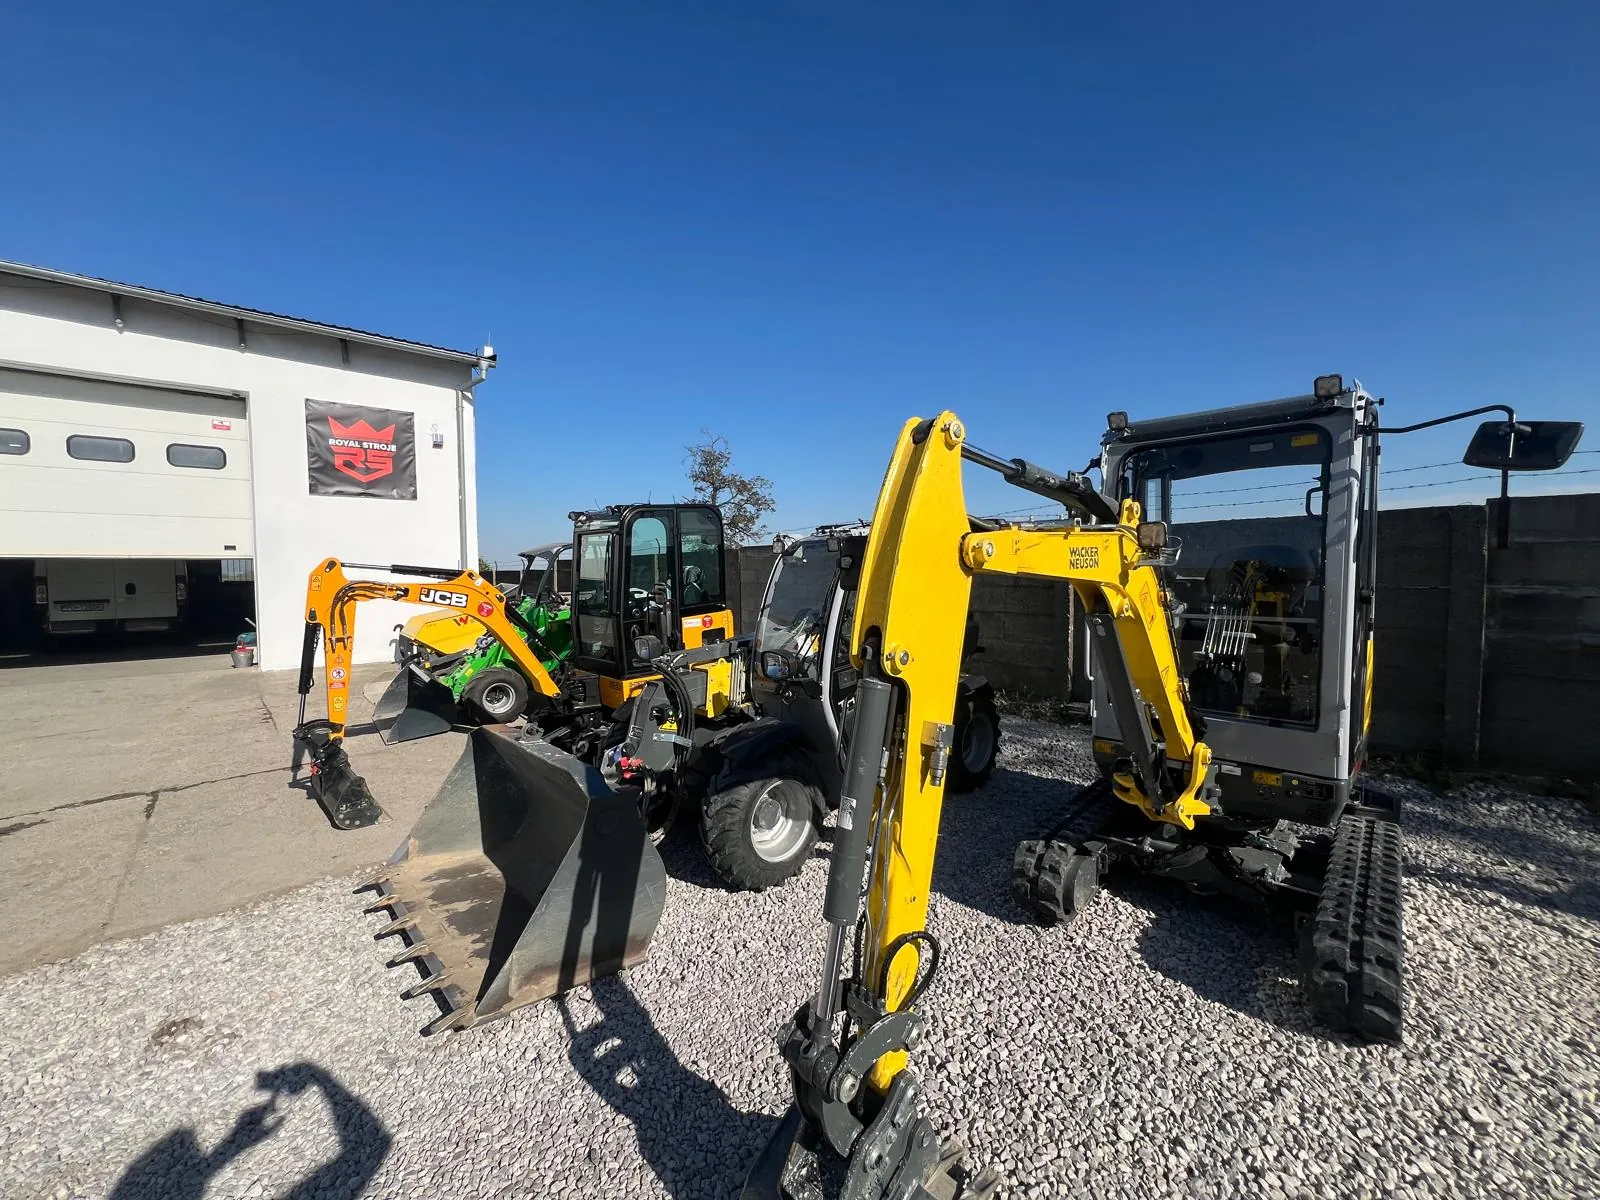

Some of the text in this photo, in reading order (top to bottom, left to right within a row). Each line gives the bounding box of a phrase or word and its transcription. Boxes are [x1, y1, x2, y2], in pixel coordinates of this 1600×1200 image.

[328, 438, 397, 452] ROYAL STROJE
[1069, 546, 1099, 558] WACKER
[1069, 558, 1099, 570] NEUSON
[420, 588, 468, 607] JCB
